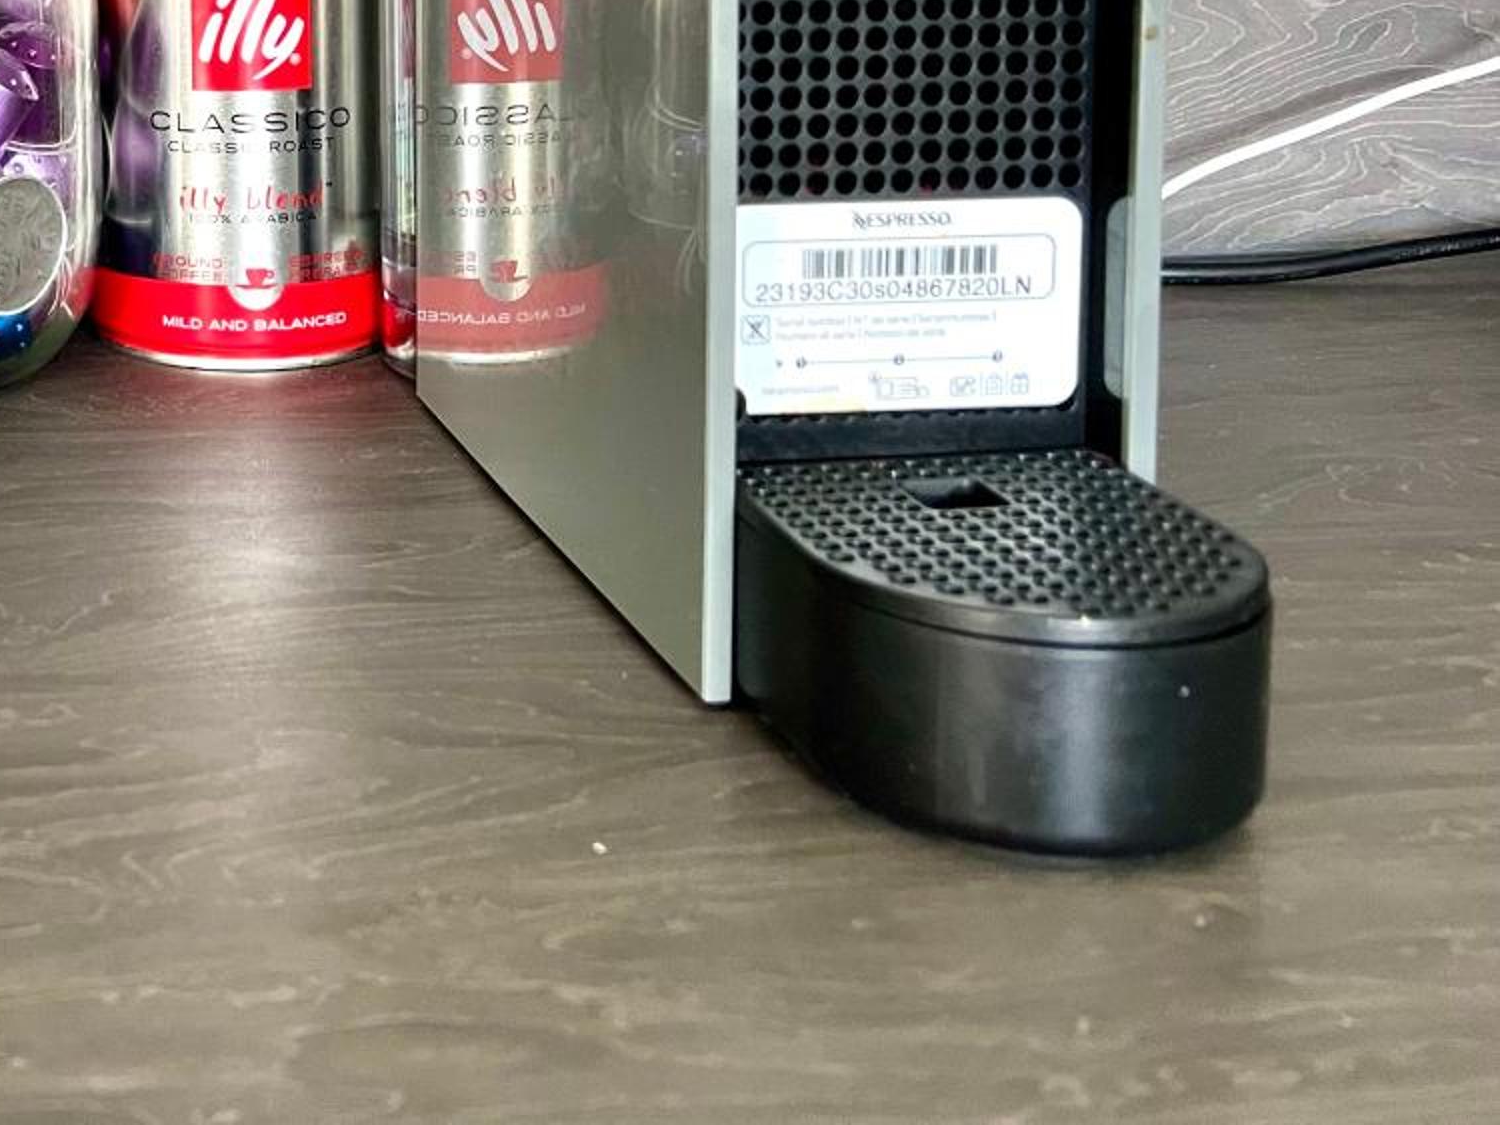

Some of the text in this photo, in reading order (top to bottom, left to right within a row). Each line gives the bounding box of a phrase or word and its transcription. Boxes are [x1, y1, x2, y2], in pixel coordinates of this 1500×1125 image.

[149, 106, 351, 134] CLASSICO
[268, 136, 335, 153] ROAST
[179, 185, 228, 213] illy
[240, 211, 318, 225] AABICA
[852, 210, 953, 230] NESPRESSO
[162, 311, 348, 332] MILD AND BALANCED
